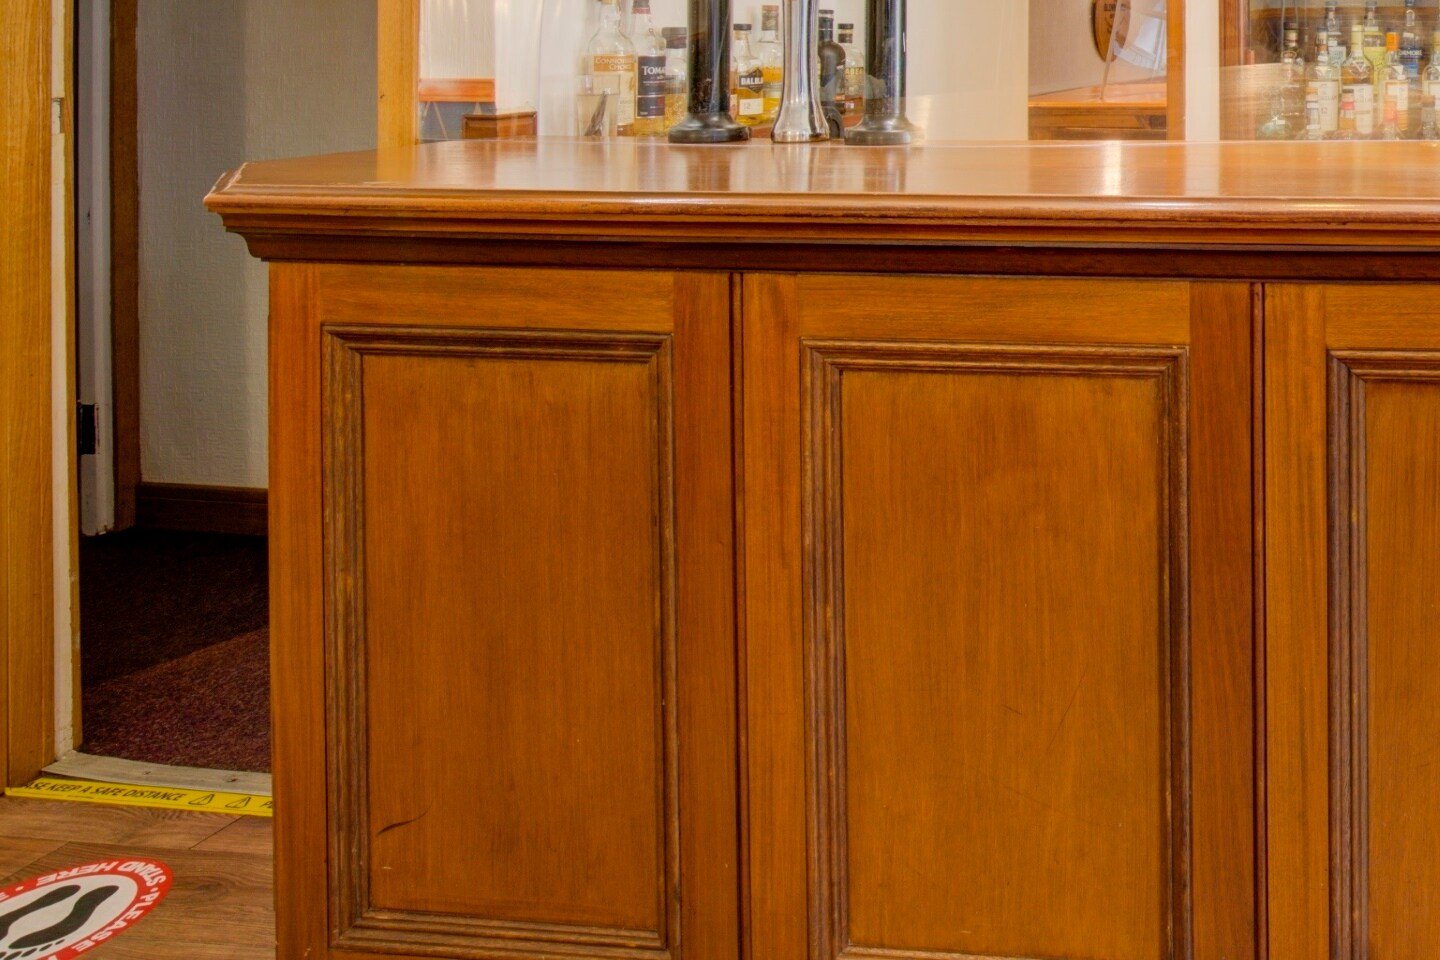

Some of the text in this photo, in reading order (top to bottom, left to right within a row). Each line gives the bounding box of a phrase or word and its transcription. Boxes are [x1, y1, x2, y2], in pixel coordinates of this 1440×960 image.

[48, 783, 81, 793] KEEP
[81, 785, 94, 794] A
[94, 786, 124, 797] SAFE
[124, 788, 187, 802] DISTANCE
[36, 861, 167, 952] PLEASE STAND HERE
